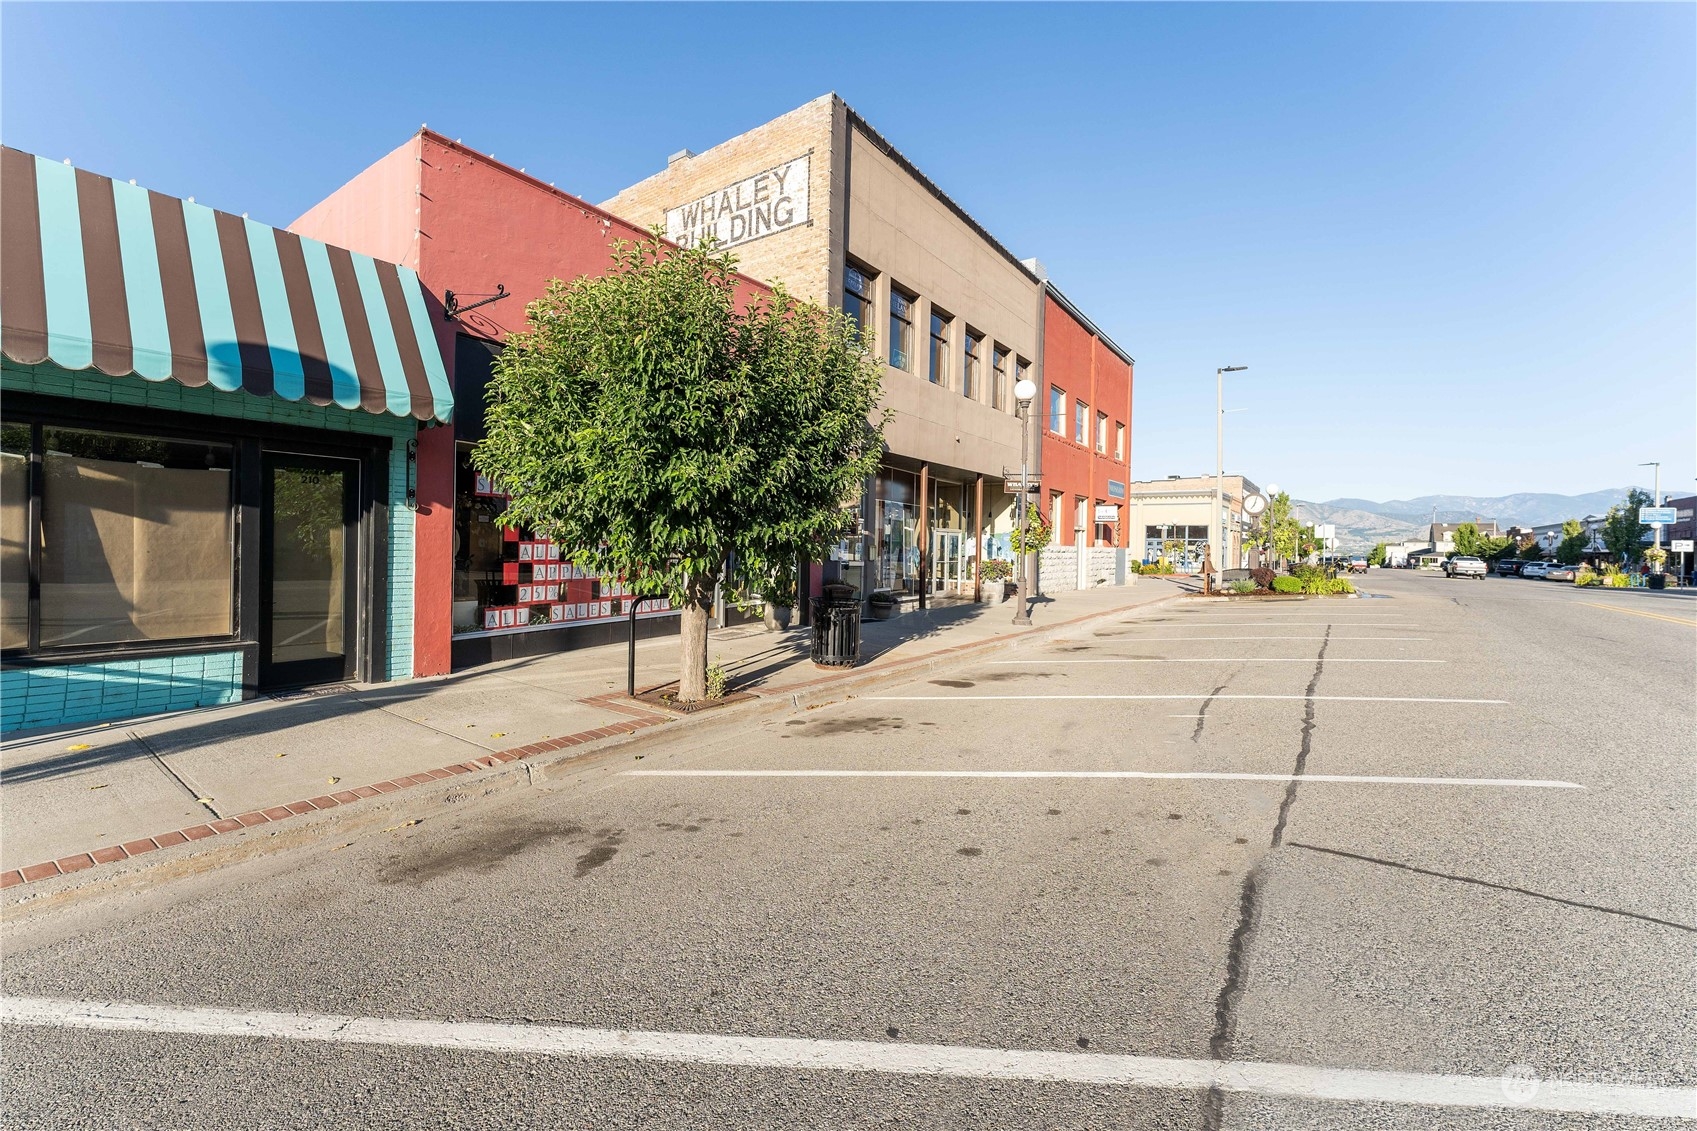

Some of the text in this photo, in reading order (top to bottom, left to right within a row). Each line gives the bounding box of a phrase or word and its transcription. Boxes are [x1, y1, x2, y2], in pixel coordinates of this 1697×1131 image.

[681, 165, 792, 231] WHALEY
[675, 196, 794, 249] BUILDING
[301, 475, 320, 484] 210
[520, 545, 557, 560] ALL
[534, 566, 607, 579] APPAR
[519, 585, 558, 601] 25%
[487, 599, 668, 627] ALL SALES FNAL
